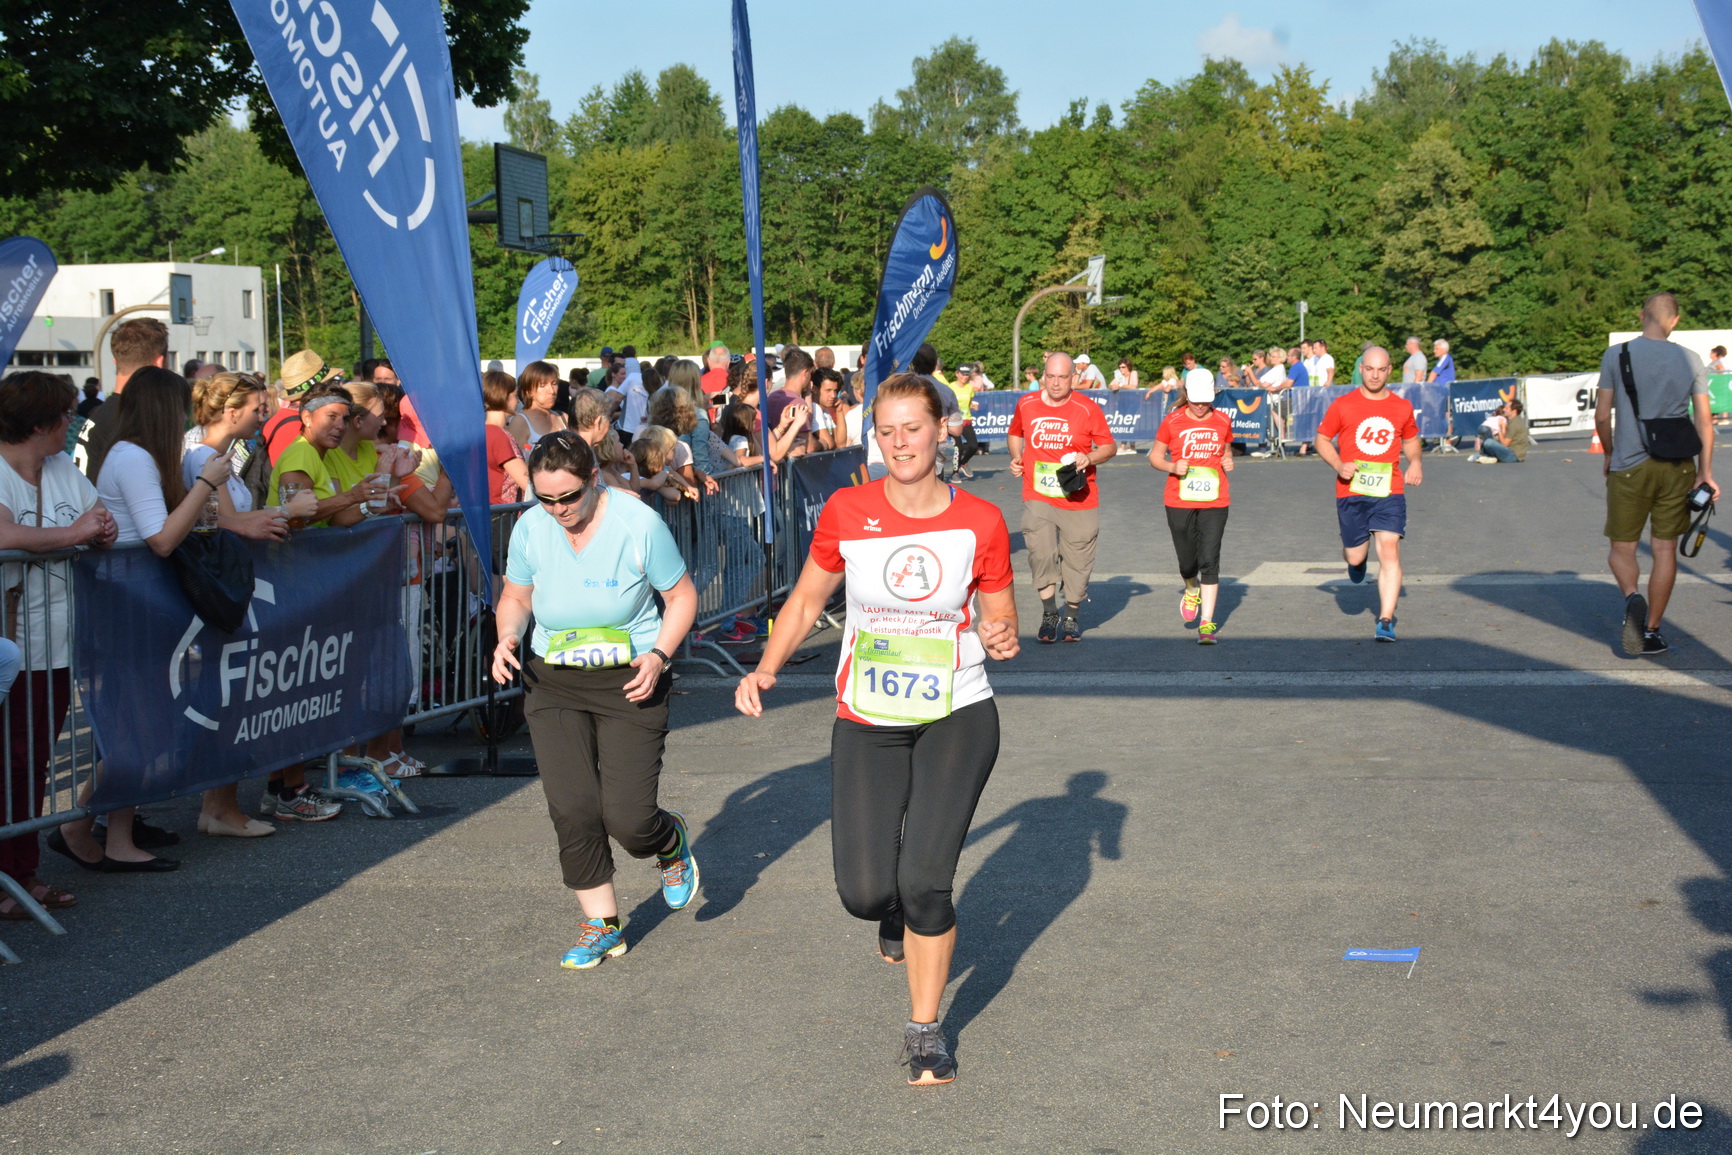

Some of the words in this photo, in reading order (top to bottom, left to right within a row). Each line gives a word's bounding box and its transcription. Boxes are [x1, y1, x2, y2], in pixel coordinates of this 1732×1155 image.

[936, 253, 954, 287] Medien
[6, 268, 45, 332] AUTOMOBILE
[530, 269, 564, 334] Fischer
[542, 282, 568, 333] AUTOMOBILE
[875, 263, 934, 358] Frischmann
[1453, 396, 1503, 413] Frischmann
[1030, 416, 1068, 432] Town
[1236, 420, 1260, 428] Medien
[1178, 427, 1217, 443] Town
[1360, 426, 1390, 446] 48
[1043, 442, 1064, 450] HAUS
[1187, 480, 1211, 492] 428
[1359, 474, 1384, 487] 507
[870, 626, 943, 637] Leistungsdiagnostik
[219, 624, 354, 708] Fischer
[554, 646, 621, 669] 1501
[864, 666, 941, 702] 1673
[233, 688, 343, 745] AUTOMOBILE
